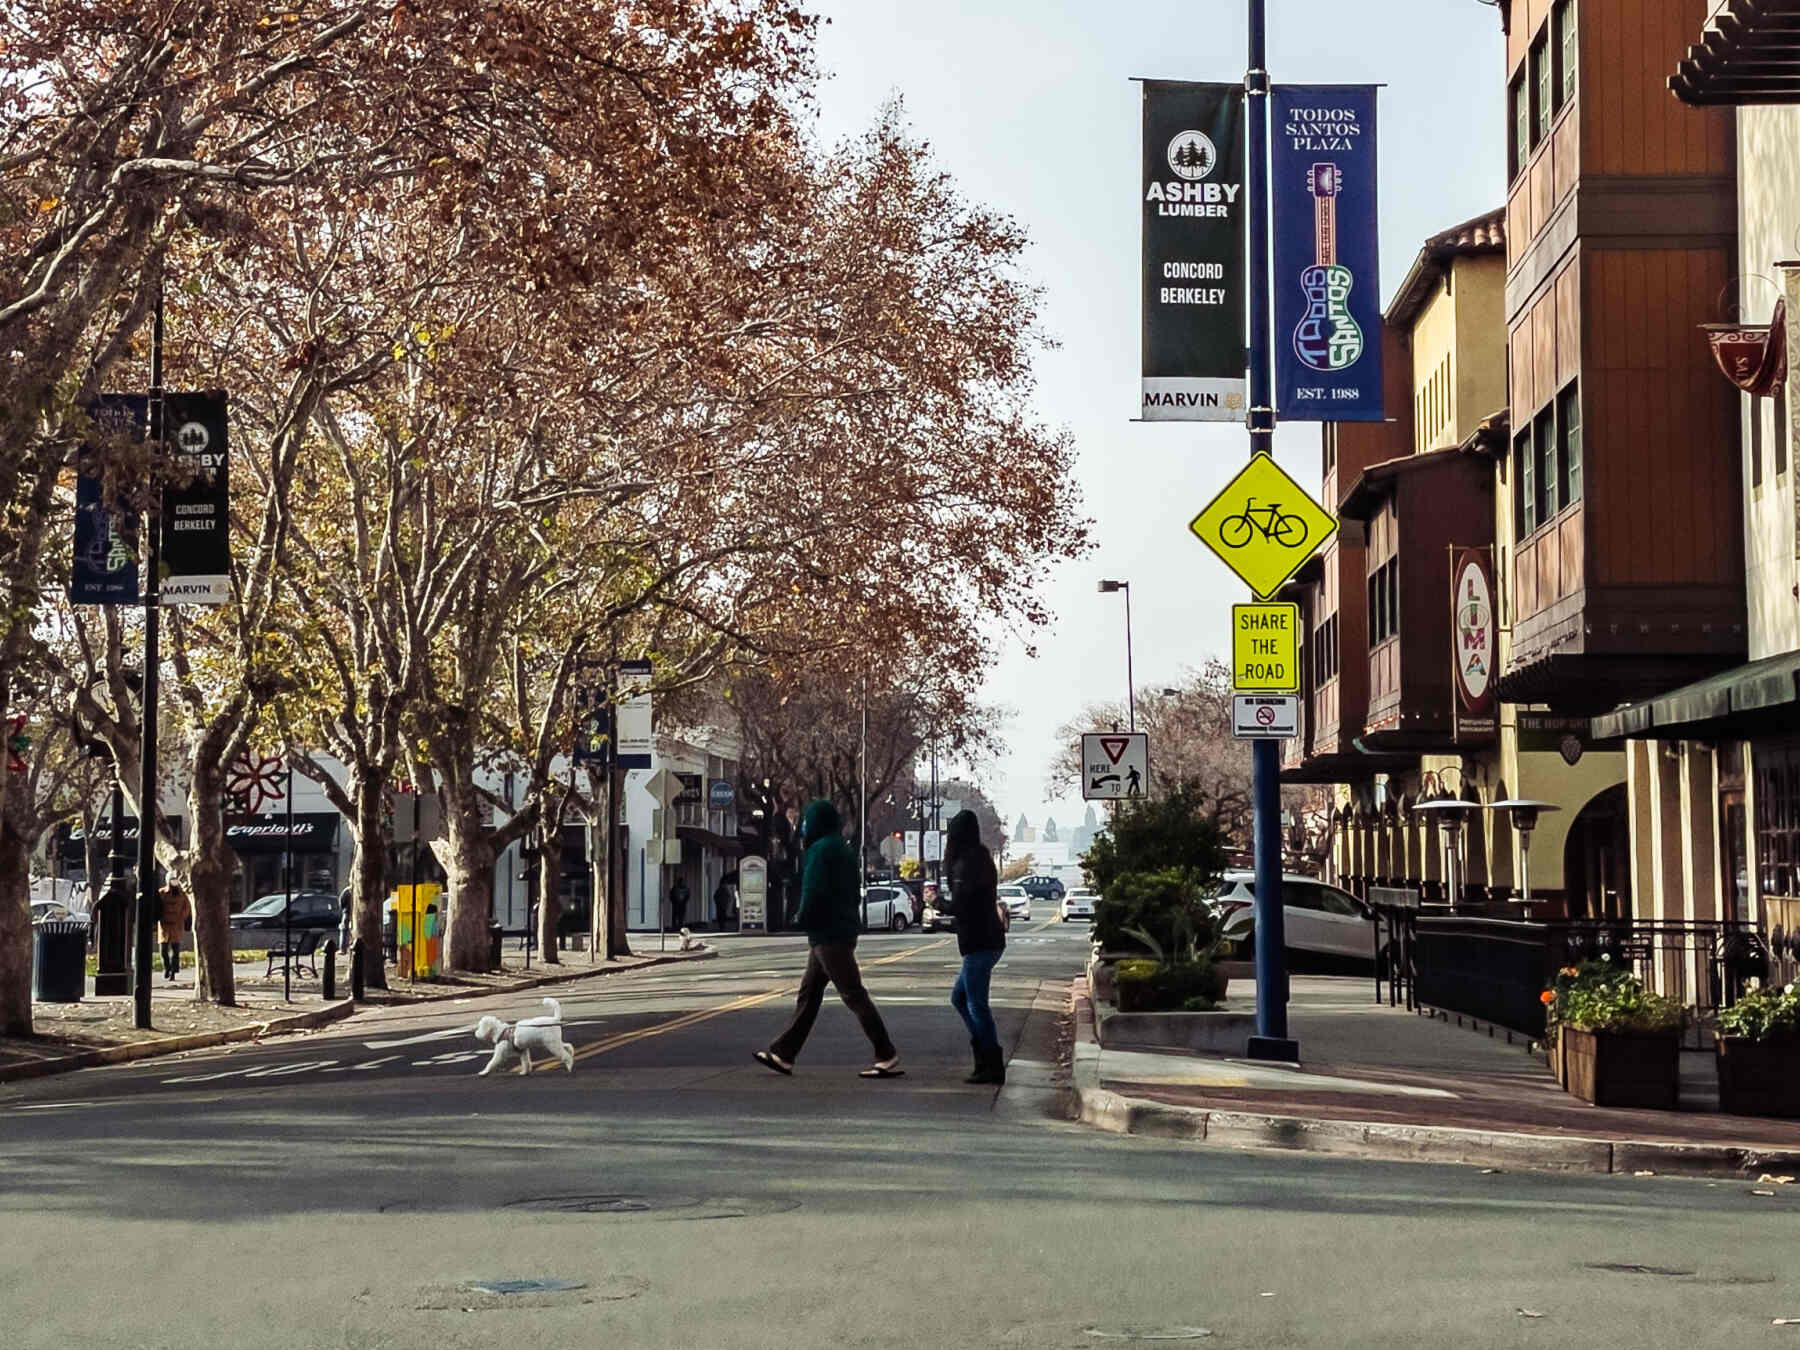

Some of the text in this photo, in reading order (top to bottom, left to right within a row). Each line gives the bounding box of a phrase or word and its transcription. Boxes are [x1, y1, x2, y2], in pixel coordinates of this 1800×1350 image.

[1289, 108, 1356, 121] TODOS
[1285, 123, 1361, 136] SANTOS
[1293, 137, 1353, 151] PLAZA
[1146, 181, 1240, 203] ASHBY
[1158, 203, 1228, 217] LUMBER
[1163, 262, 1223, 279] CONCORD
[1160, 287, 1226, 304] BERKELEY
[1298, 269, 1327, 366] TODOS
[1327, 269, 1360, 367] SANTOS
[1144, 392, 1218, 407] MARVIN
[1296, 387, 1360, 400] EST. 1988
[176, 504, 215, 515] CONCORD
[174, 519, 217, 531] BERKELEY
[163, 585, 211, 595] MARVIN
[1241, 614, 1288, 630] SHARE
[1464, 579, 1486, 676] LIMA
[1251, 639, 1278, 654] THE
[1245, 663, 1285, 679] ROAD
[1522, 718, 1541, 728] THE
[1090, 764, 1112, 774] HERE
[1110, 783, 1121, 793] TO
